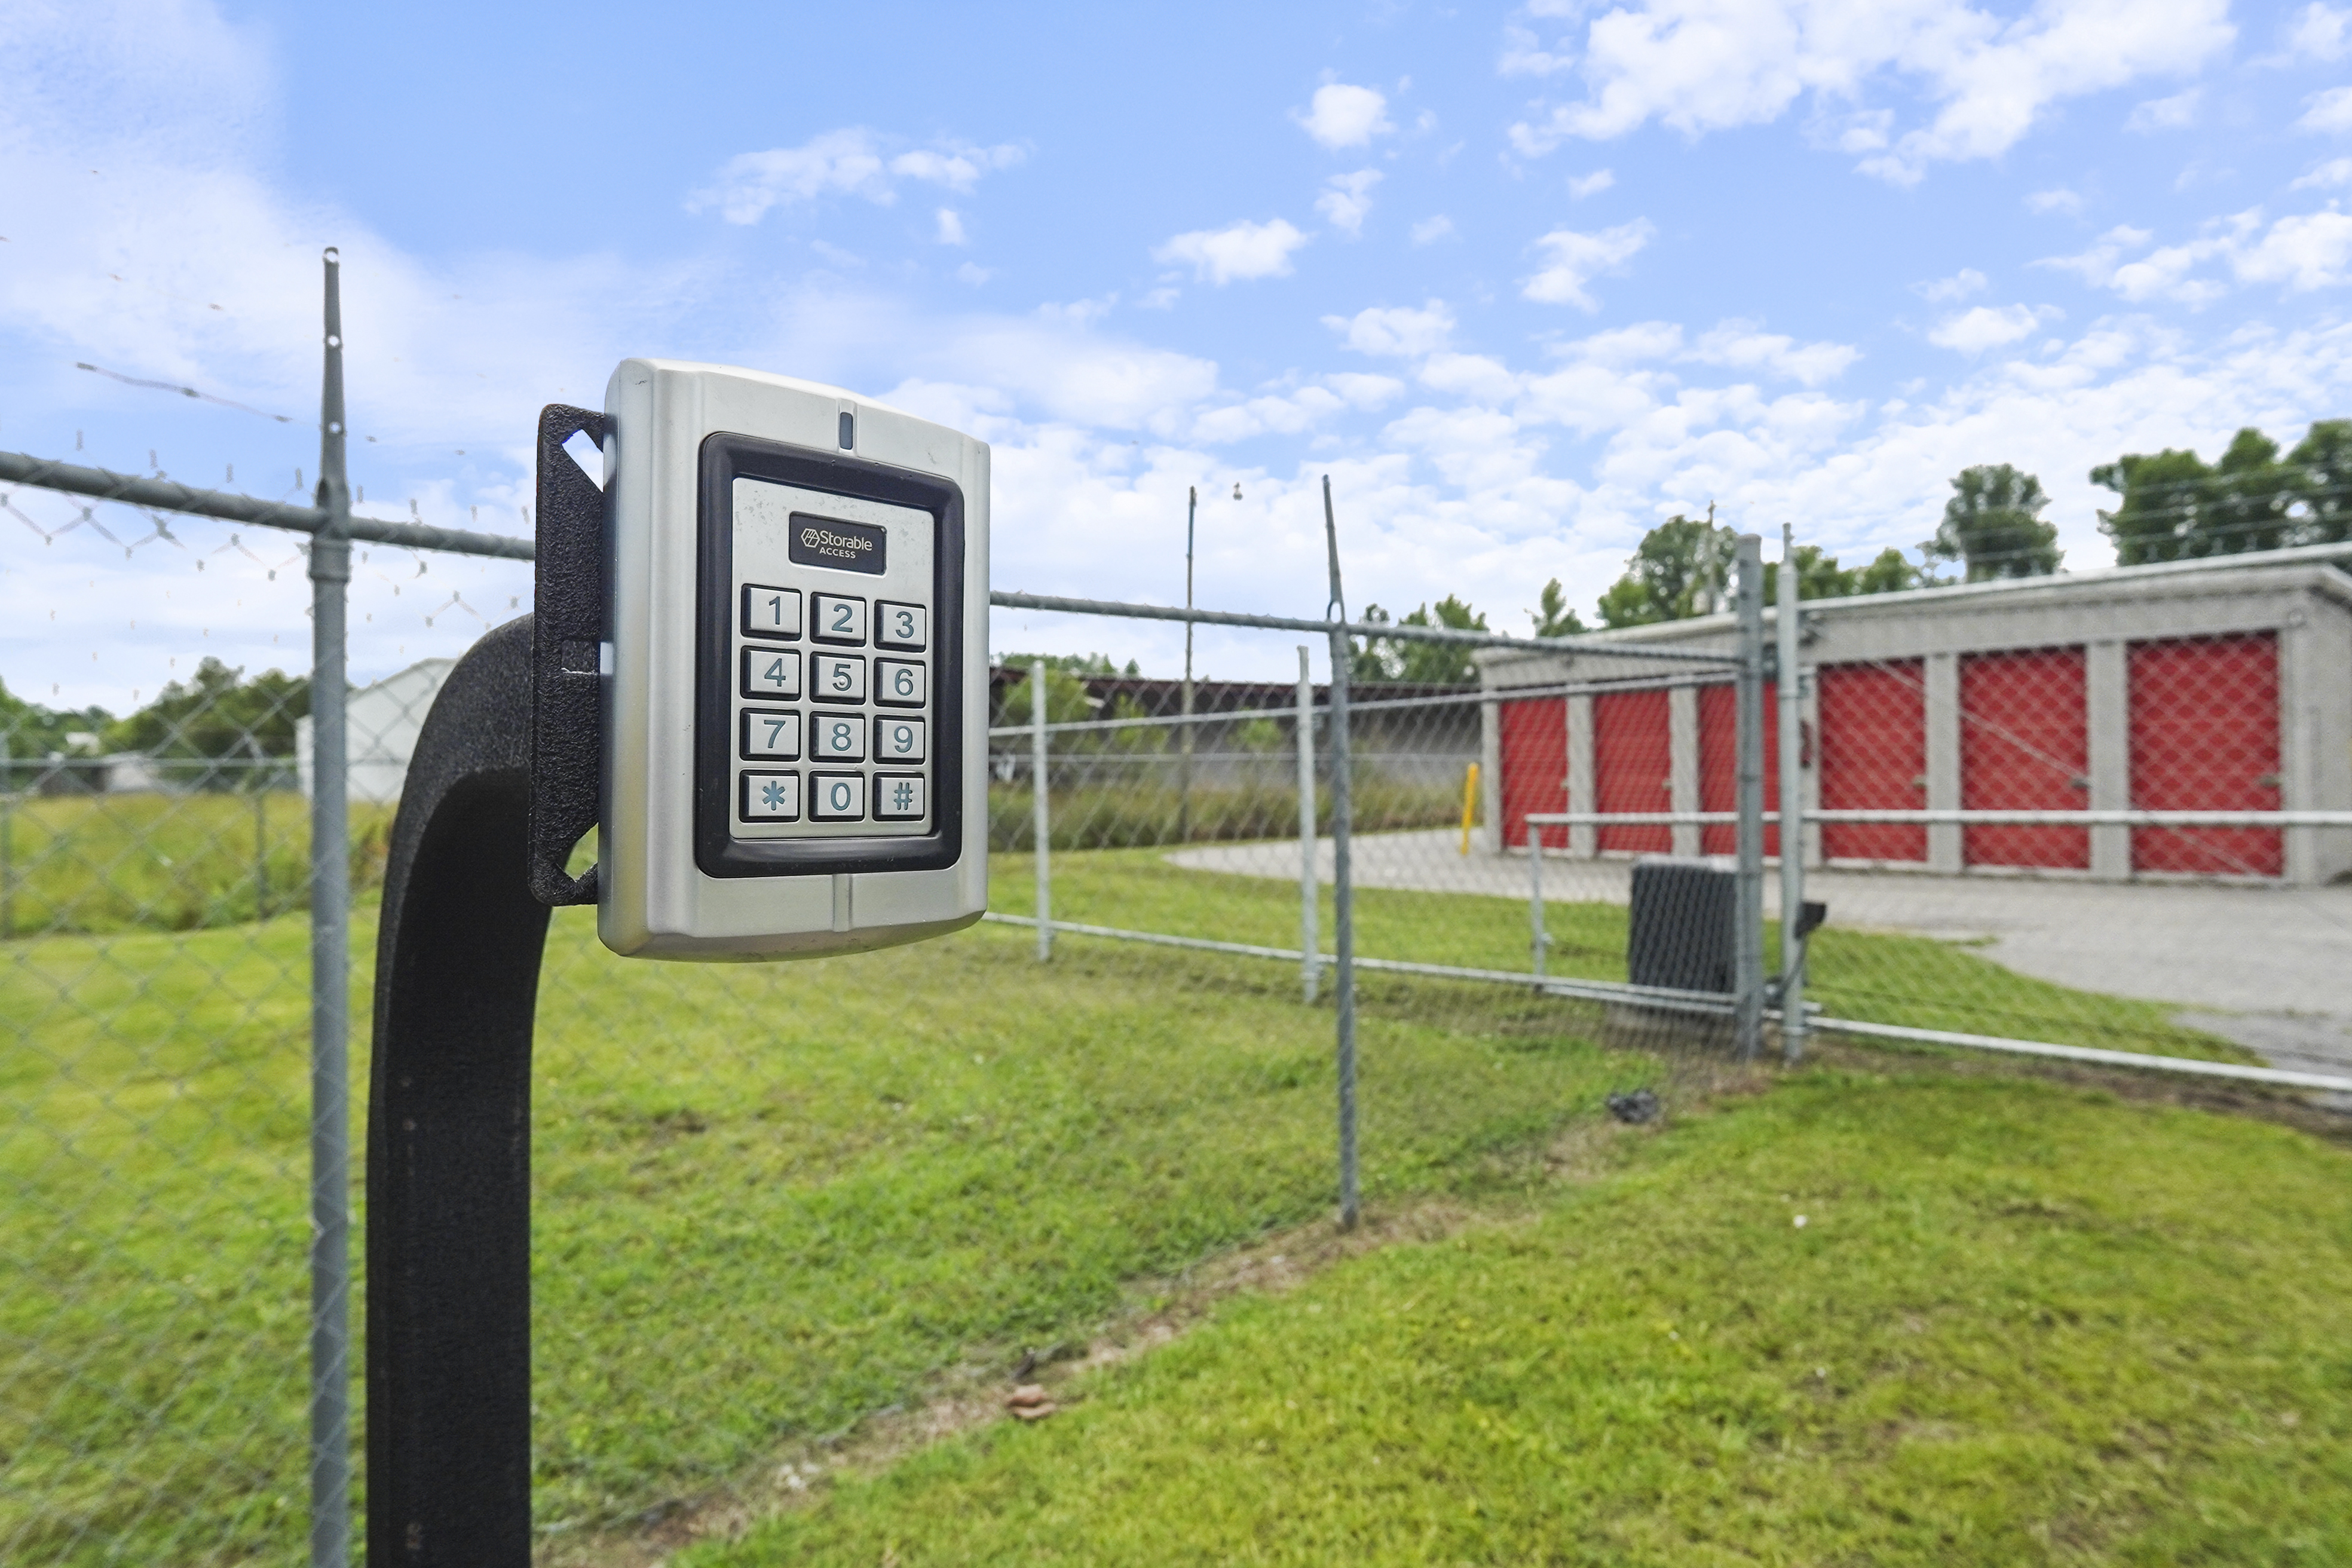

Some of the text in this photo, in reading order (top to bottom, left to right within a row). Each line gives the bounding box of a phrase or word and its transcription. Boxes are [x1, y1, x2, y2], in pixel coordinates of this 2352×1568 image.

[819, 547, 856, 559] ACCESS
[820, 530, 872, 551] Storable
[768, 596, 914, 638] 1 2 3
[764, 659, 914, 696] 4 5 6
[764, 720, 913, 753] 7 8 9
[831, 782, 851, 811] 0
[893, 782, 913, 810] #
